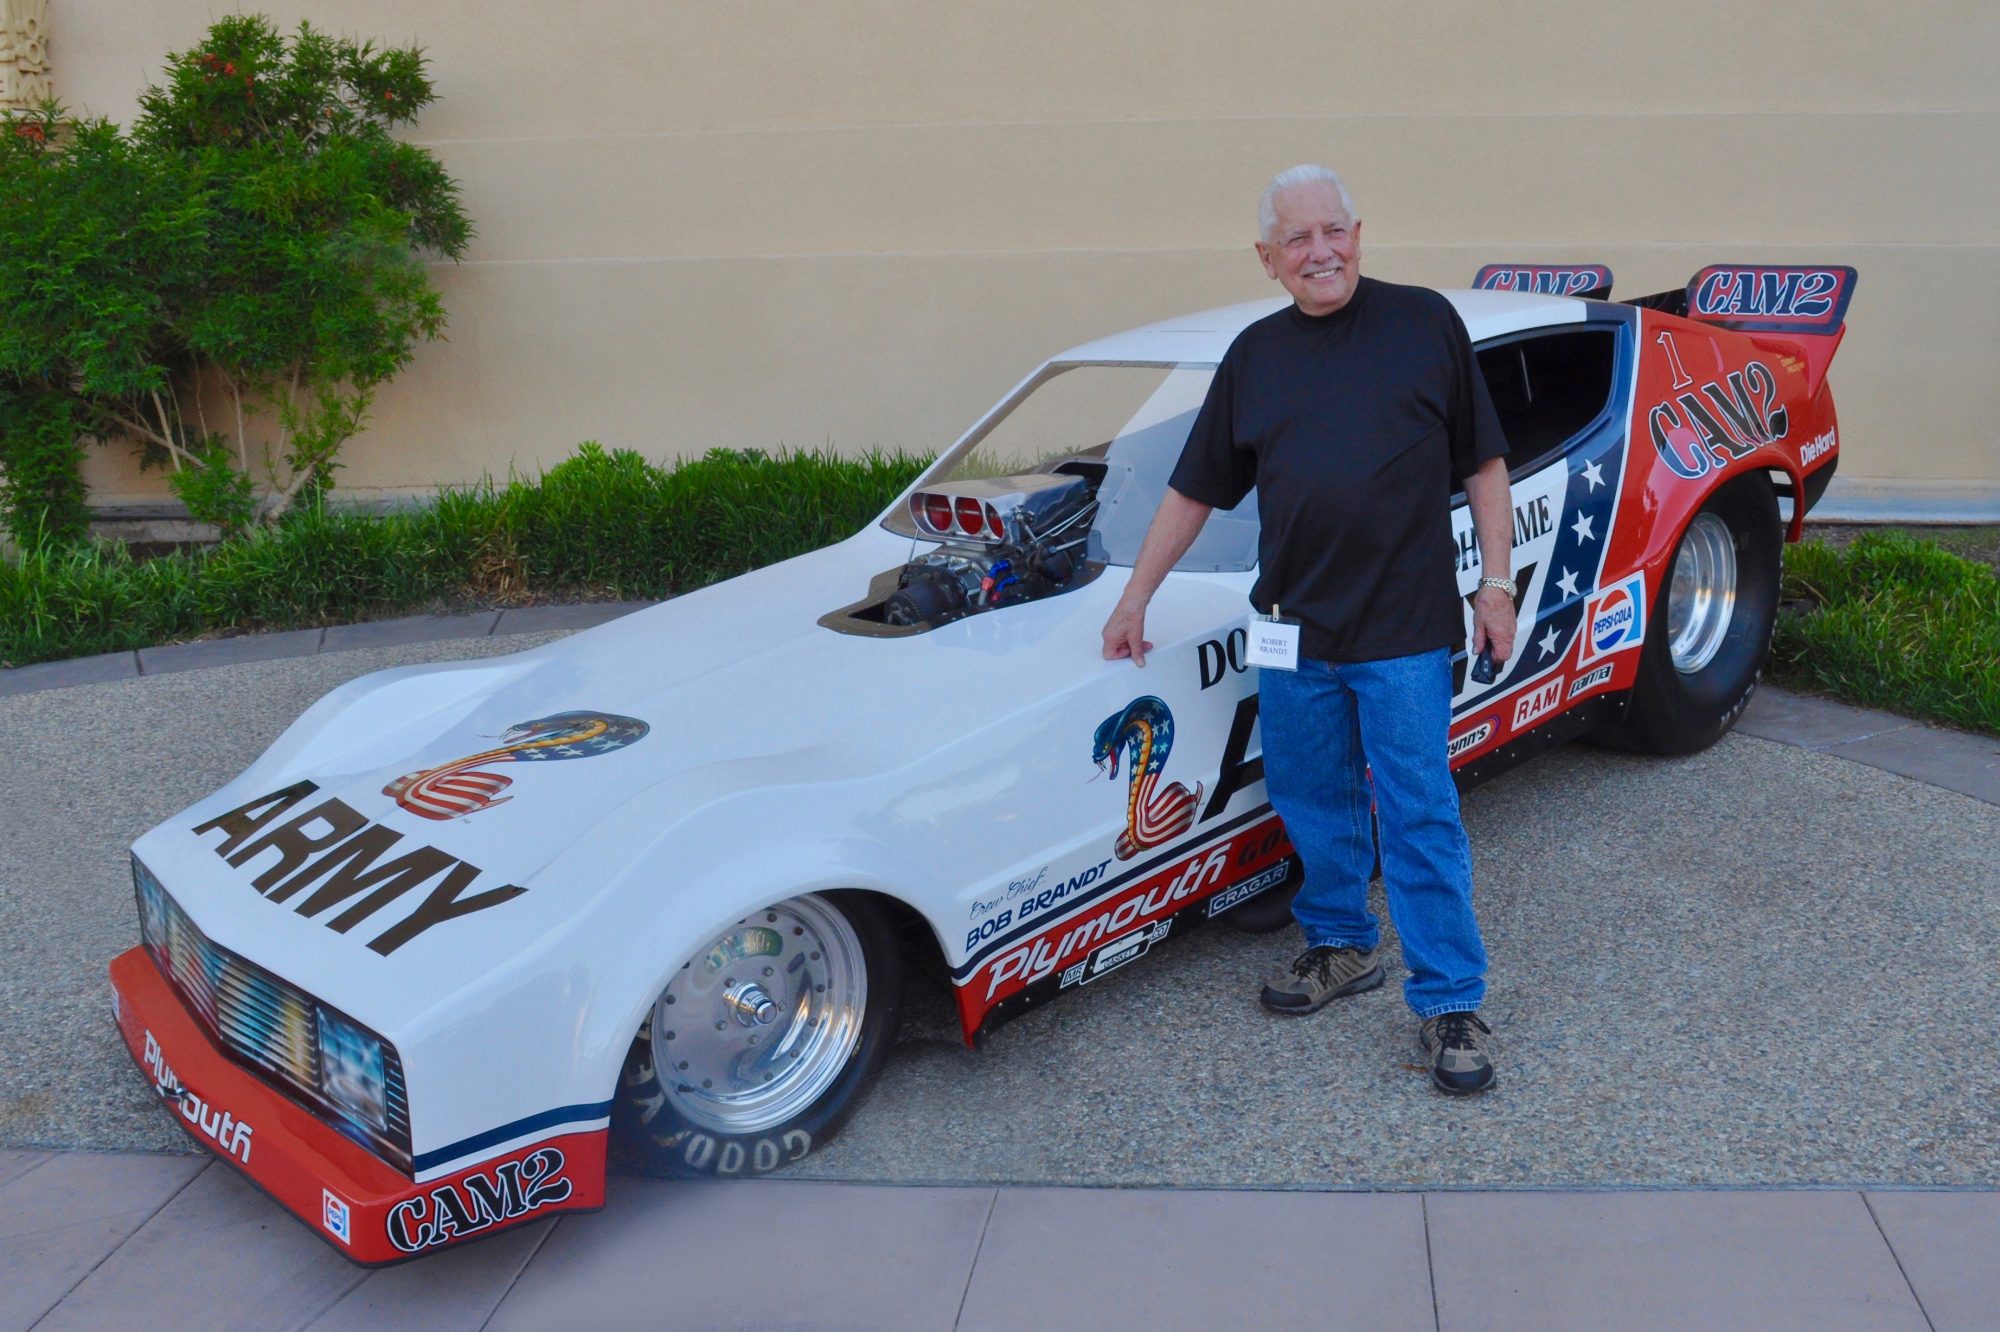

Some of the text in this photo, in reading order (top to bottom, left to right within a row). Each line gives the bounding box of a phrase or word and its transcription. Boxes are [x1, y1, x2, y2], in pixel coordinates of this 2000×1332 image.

[1482, 270, 1599, 296] CAM2
[1695, 271, 1837, 317] CAM2
[1656, 331, 1692, 391] 1
[1648, 360, 1788, 480] CAM2
[1800, 425, 1836, 468] DieHard
[1261, 636, 1287, 647] ROBERT
[1593, 605, 1632, 636] PEPSI-COLA
[1197, 627, 1249, 691] DO
[1259, 645, 1288, 656] BRANDT
[1516, 681, 1560, 724] RAM
[1447, 725, 1487, 757] ynn's
[190, 779, 529, 958] ARMY
[1213, 867, 1284, 911] CRAGAR
[965, 857, 1113, 953] BOB BRANDT
[984, 842, 1232, 1002] Plymouth
[1103, 948, 1133, 969] GASKET
[386, 1147, 572, 1253] CAM2
